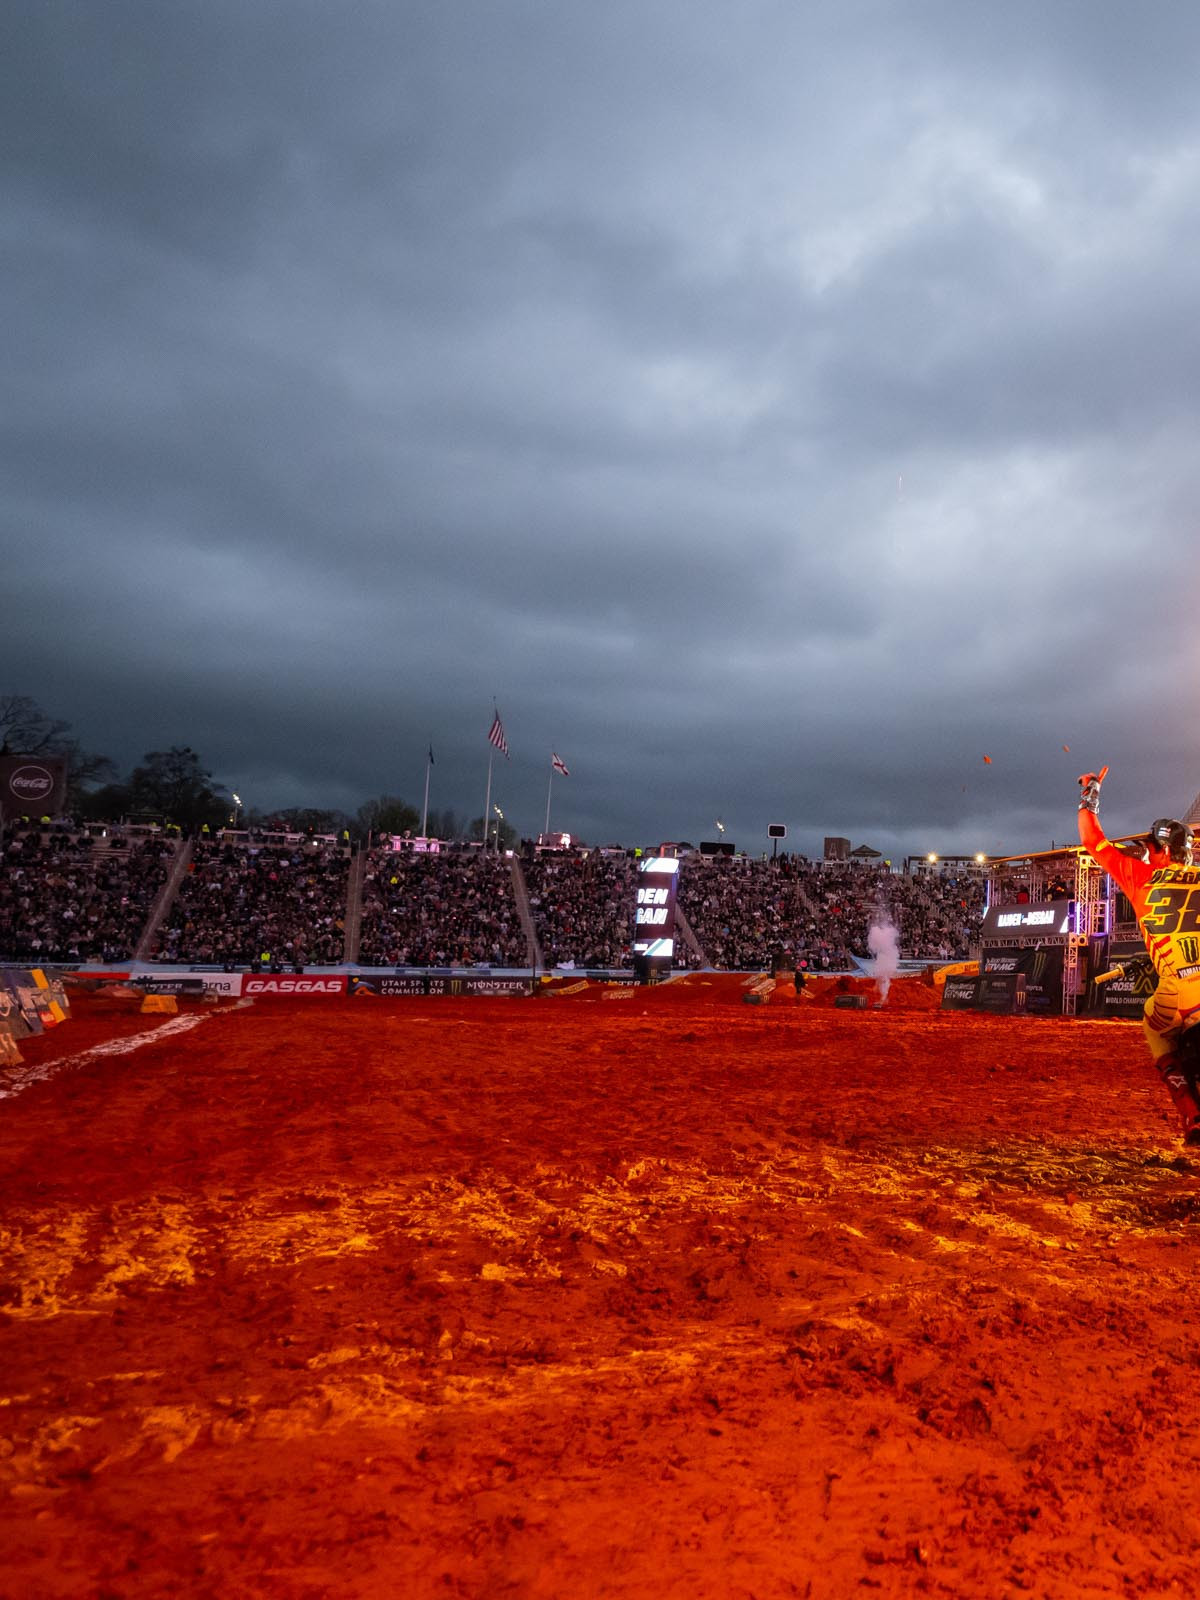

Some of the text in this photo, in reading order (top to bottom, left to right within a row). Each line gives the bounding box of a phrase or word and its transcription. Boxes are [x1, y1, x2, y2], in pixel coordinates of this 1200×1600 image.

[245, 980, 343, 993] GASGAS
[466, 980, 525, 990] MONSTER
[1123, 997, 1147, 1005] CHAMPIO
